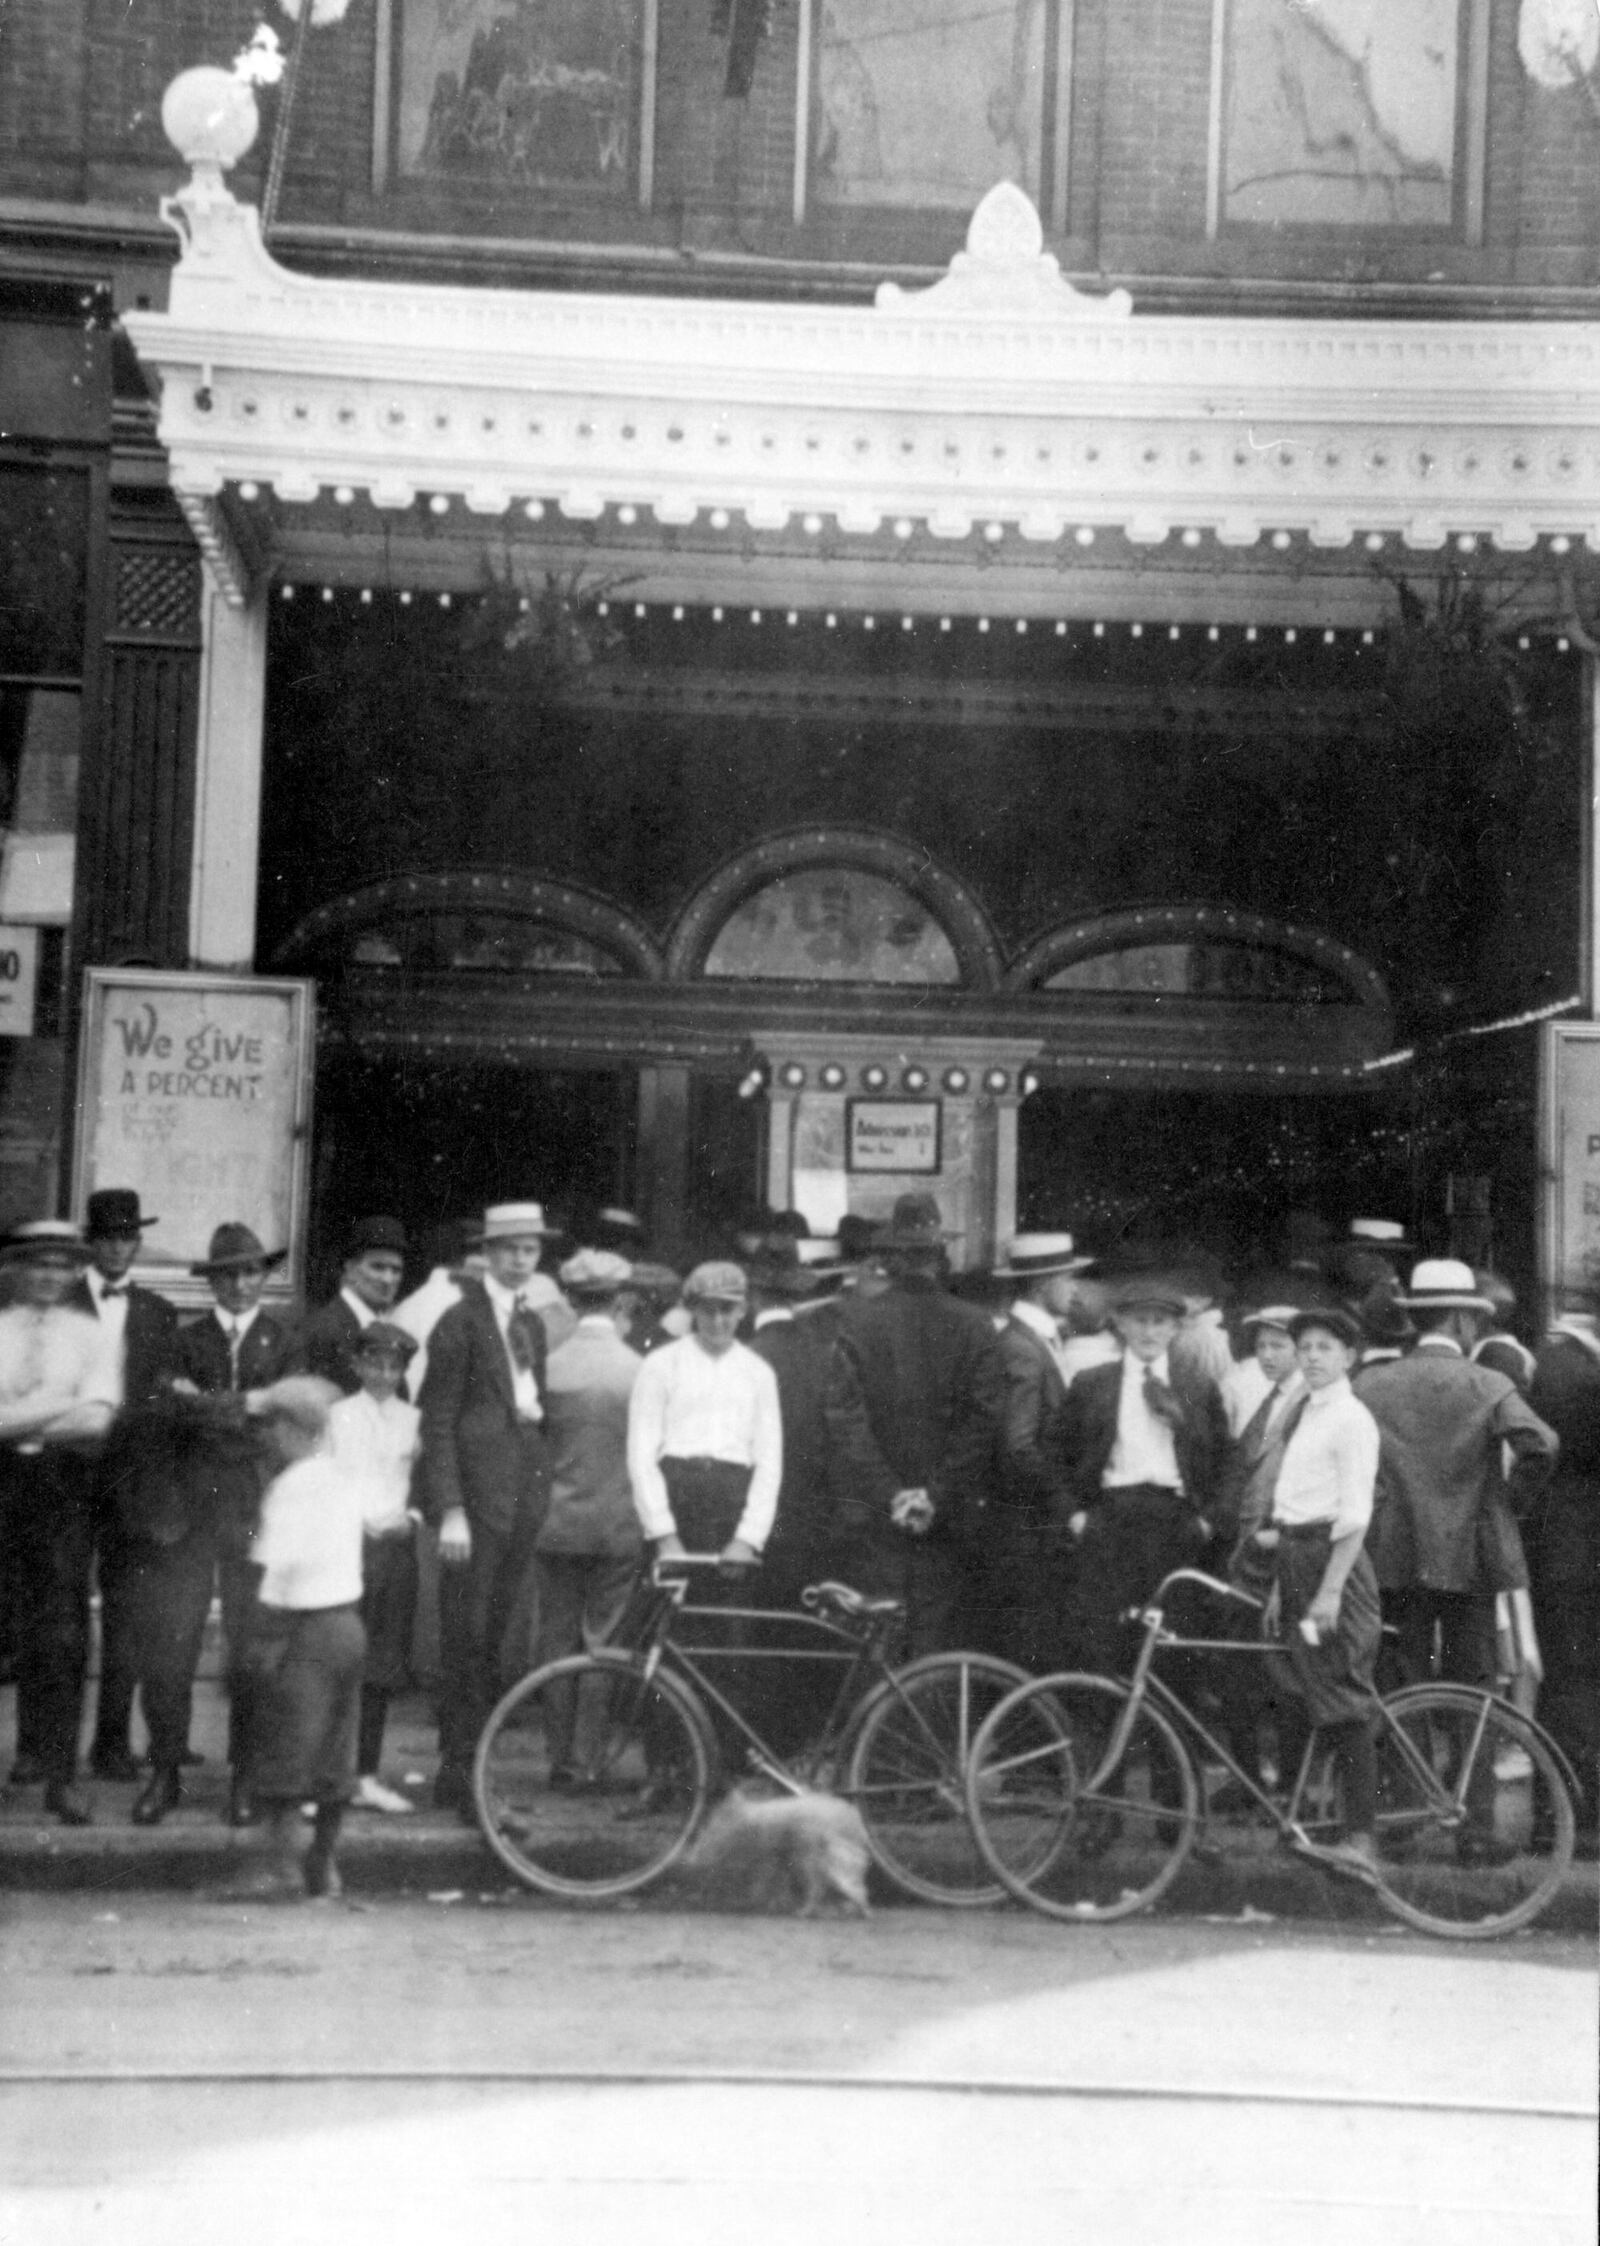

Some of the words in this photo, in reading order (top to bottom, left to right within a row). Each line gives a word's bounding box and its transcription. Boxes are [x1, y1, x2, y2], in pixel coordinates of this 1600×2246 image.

[112, 1002, 173, 1059] We
[119, 1068, 136, 1095] A
[147, 1070, 263, 1100] PERCENT
